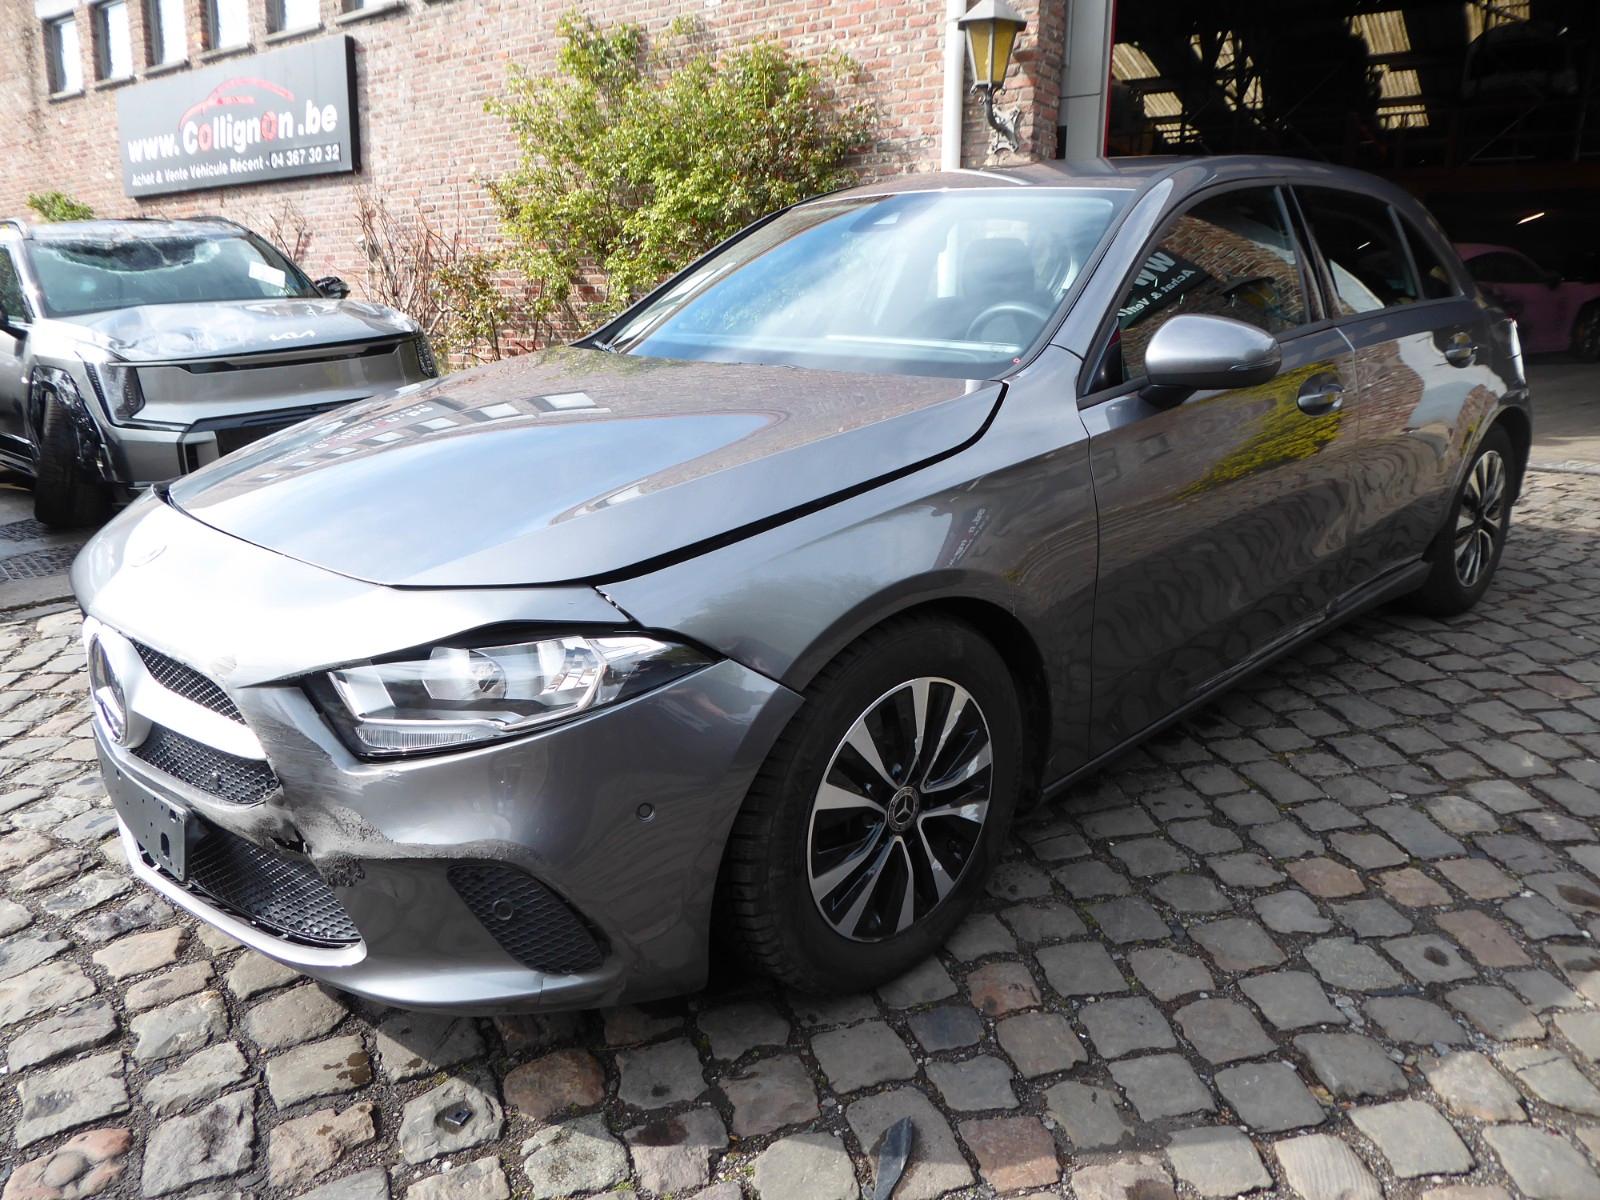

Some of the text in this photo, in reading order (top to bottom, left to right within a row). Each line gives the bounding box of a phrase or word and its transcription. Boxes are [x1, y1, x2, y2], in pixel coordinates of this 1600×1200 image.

[132, 172, 155, 186] Achat
[164, 168, 188, 182] Vente
[270, 152, 284, 168] 04
[308, 146, 322, 163] 30
[324, 144, 340, 161] 32
